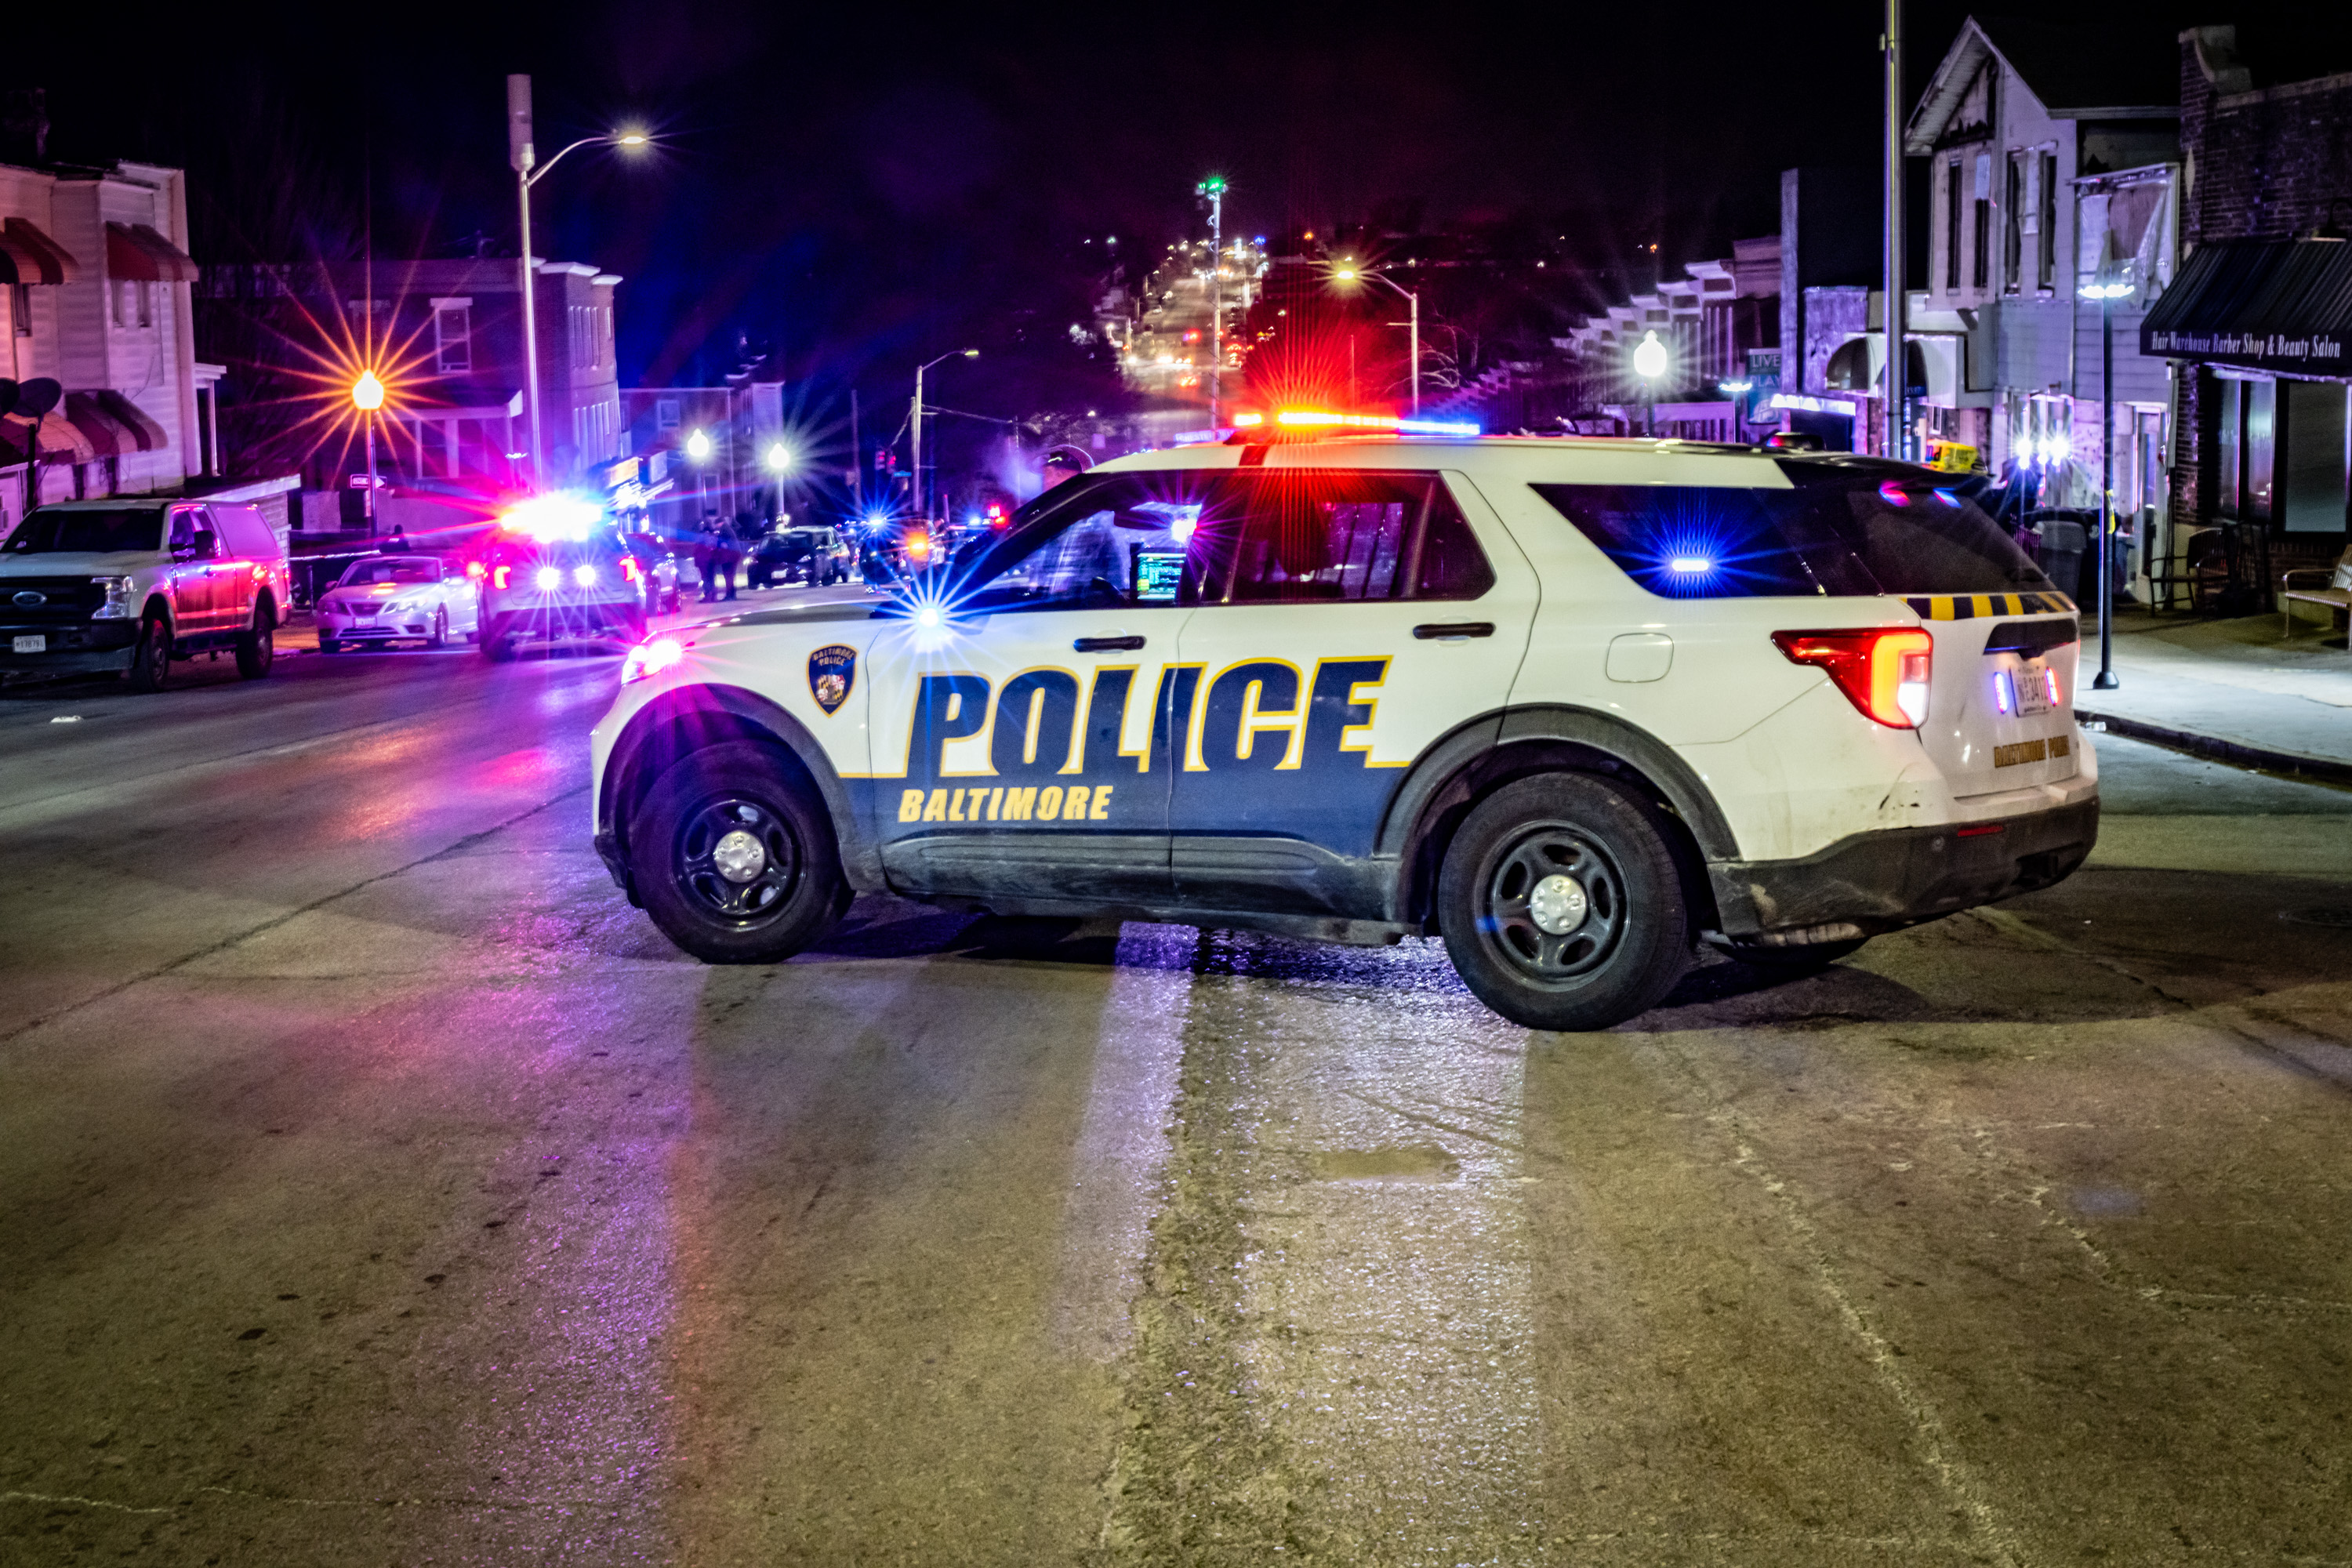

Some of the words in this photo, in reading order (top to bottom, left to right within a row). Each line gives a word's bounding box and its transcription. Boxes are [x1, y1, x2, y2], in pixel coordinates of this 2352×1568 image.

[2152, 331, 2169, 350] Hair
[2170, 331, 2210, 352] Warehouse
[2213, 333, 2241, 354] Barber
[2243, 332, 2264, 360] Shop
[2268, 334, 2274, 355] &
[2278, 335, 2309, 361] Beauty
[2312, 335, 2340, 358] Salon
[1752, 354, 1780, 368] LIVE
[813, 648, 855, 660] BALTIMORE
[819, 656, 845, 666] POLICE
[906, 655, 1392, 778] POLICE
[898, 785, 1113, 823] BALTIMORE
